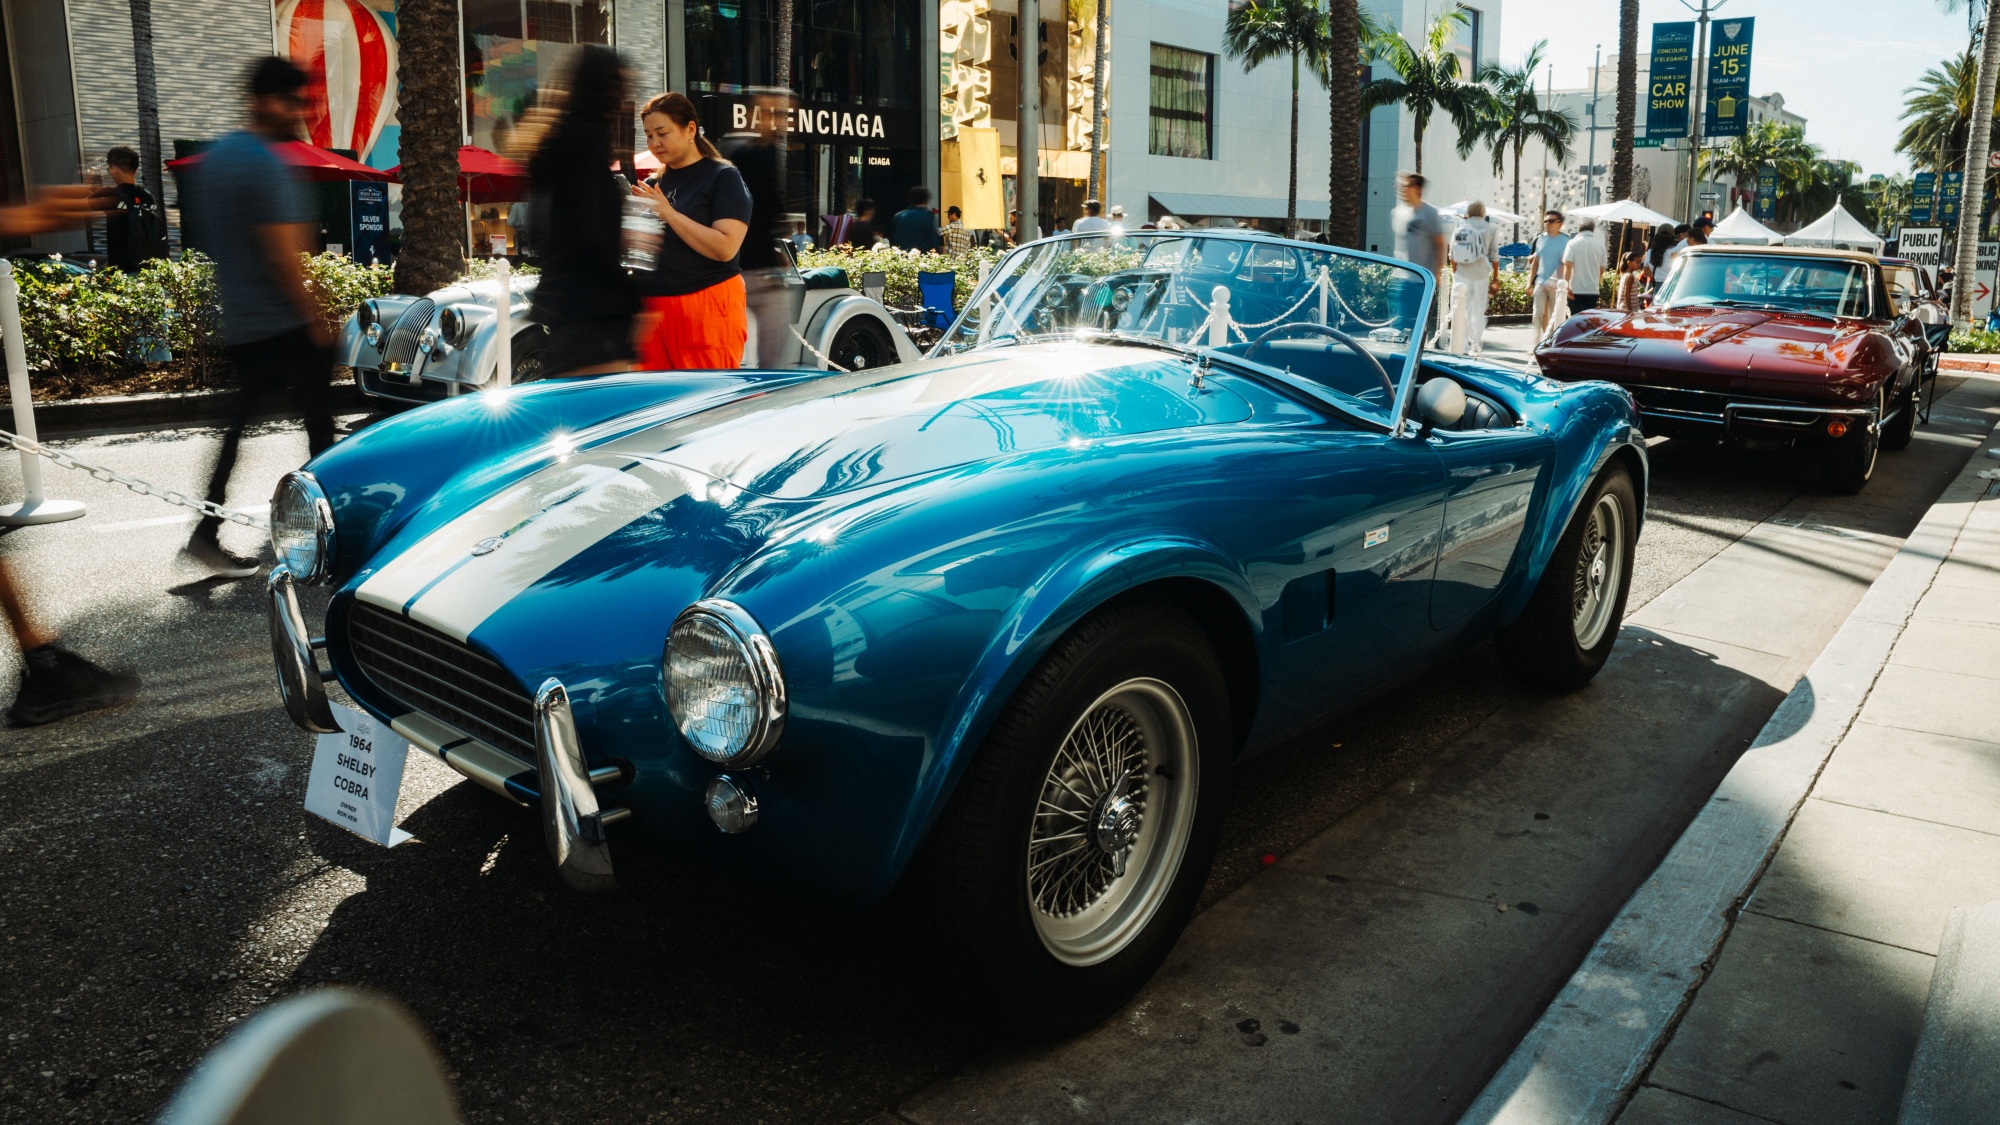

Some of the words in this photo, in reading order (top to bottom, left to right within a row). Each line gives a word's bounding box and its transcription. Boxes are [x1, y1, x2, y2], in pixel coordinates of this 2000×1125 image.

[1713, 44, 1749, 57] JUNE
[1654, 55, 1689, 63] D'ELEGANCE
[1652, 83, 1686, 97] CAR
[1651, 99, 1685, 109] SHOW
[849, 156, 891, 166] BALCIAGA
[362, 215, 380, 223] SILVER
[1902, 233, 1938, 247] PUBLIC
[1976, 245, 1997, 257] BLIC
[1976, 260, 1997, 271] RKING
[349, 734, 372, 753] 1964
[336, 753, 376, 778] SHELBY
[334, 775, 369, 800] COBRA
[340, 801, 357, 812] OWNER
